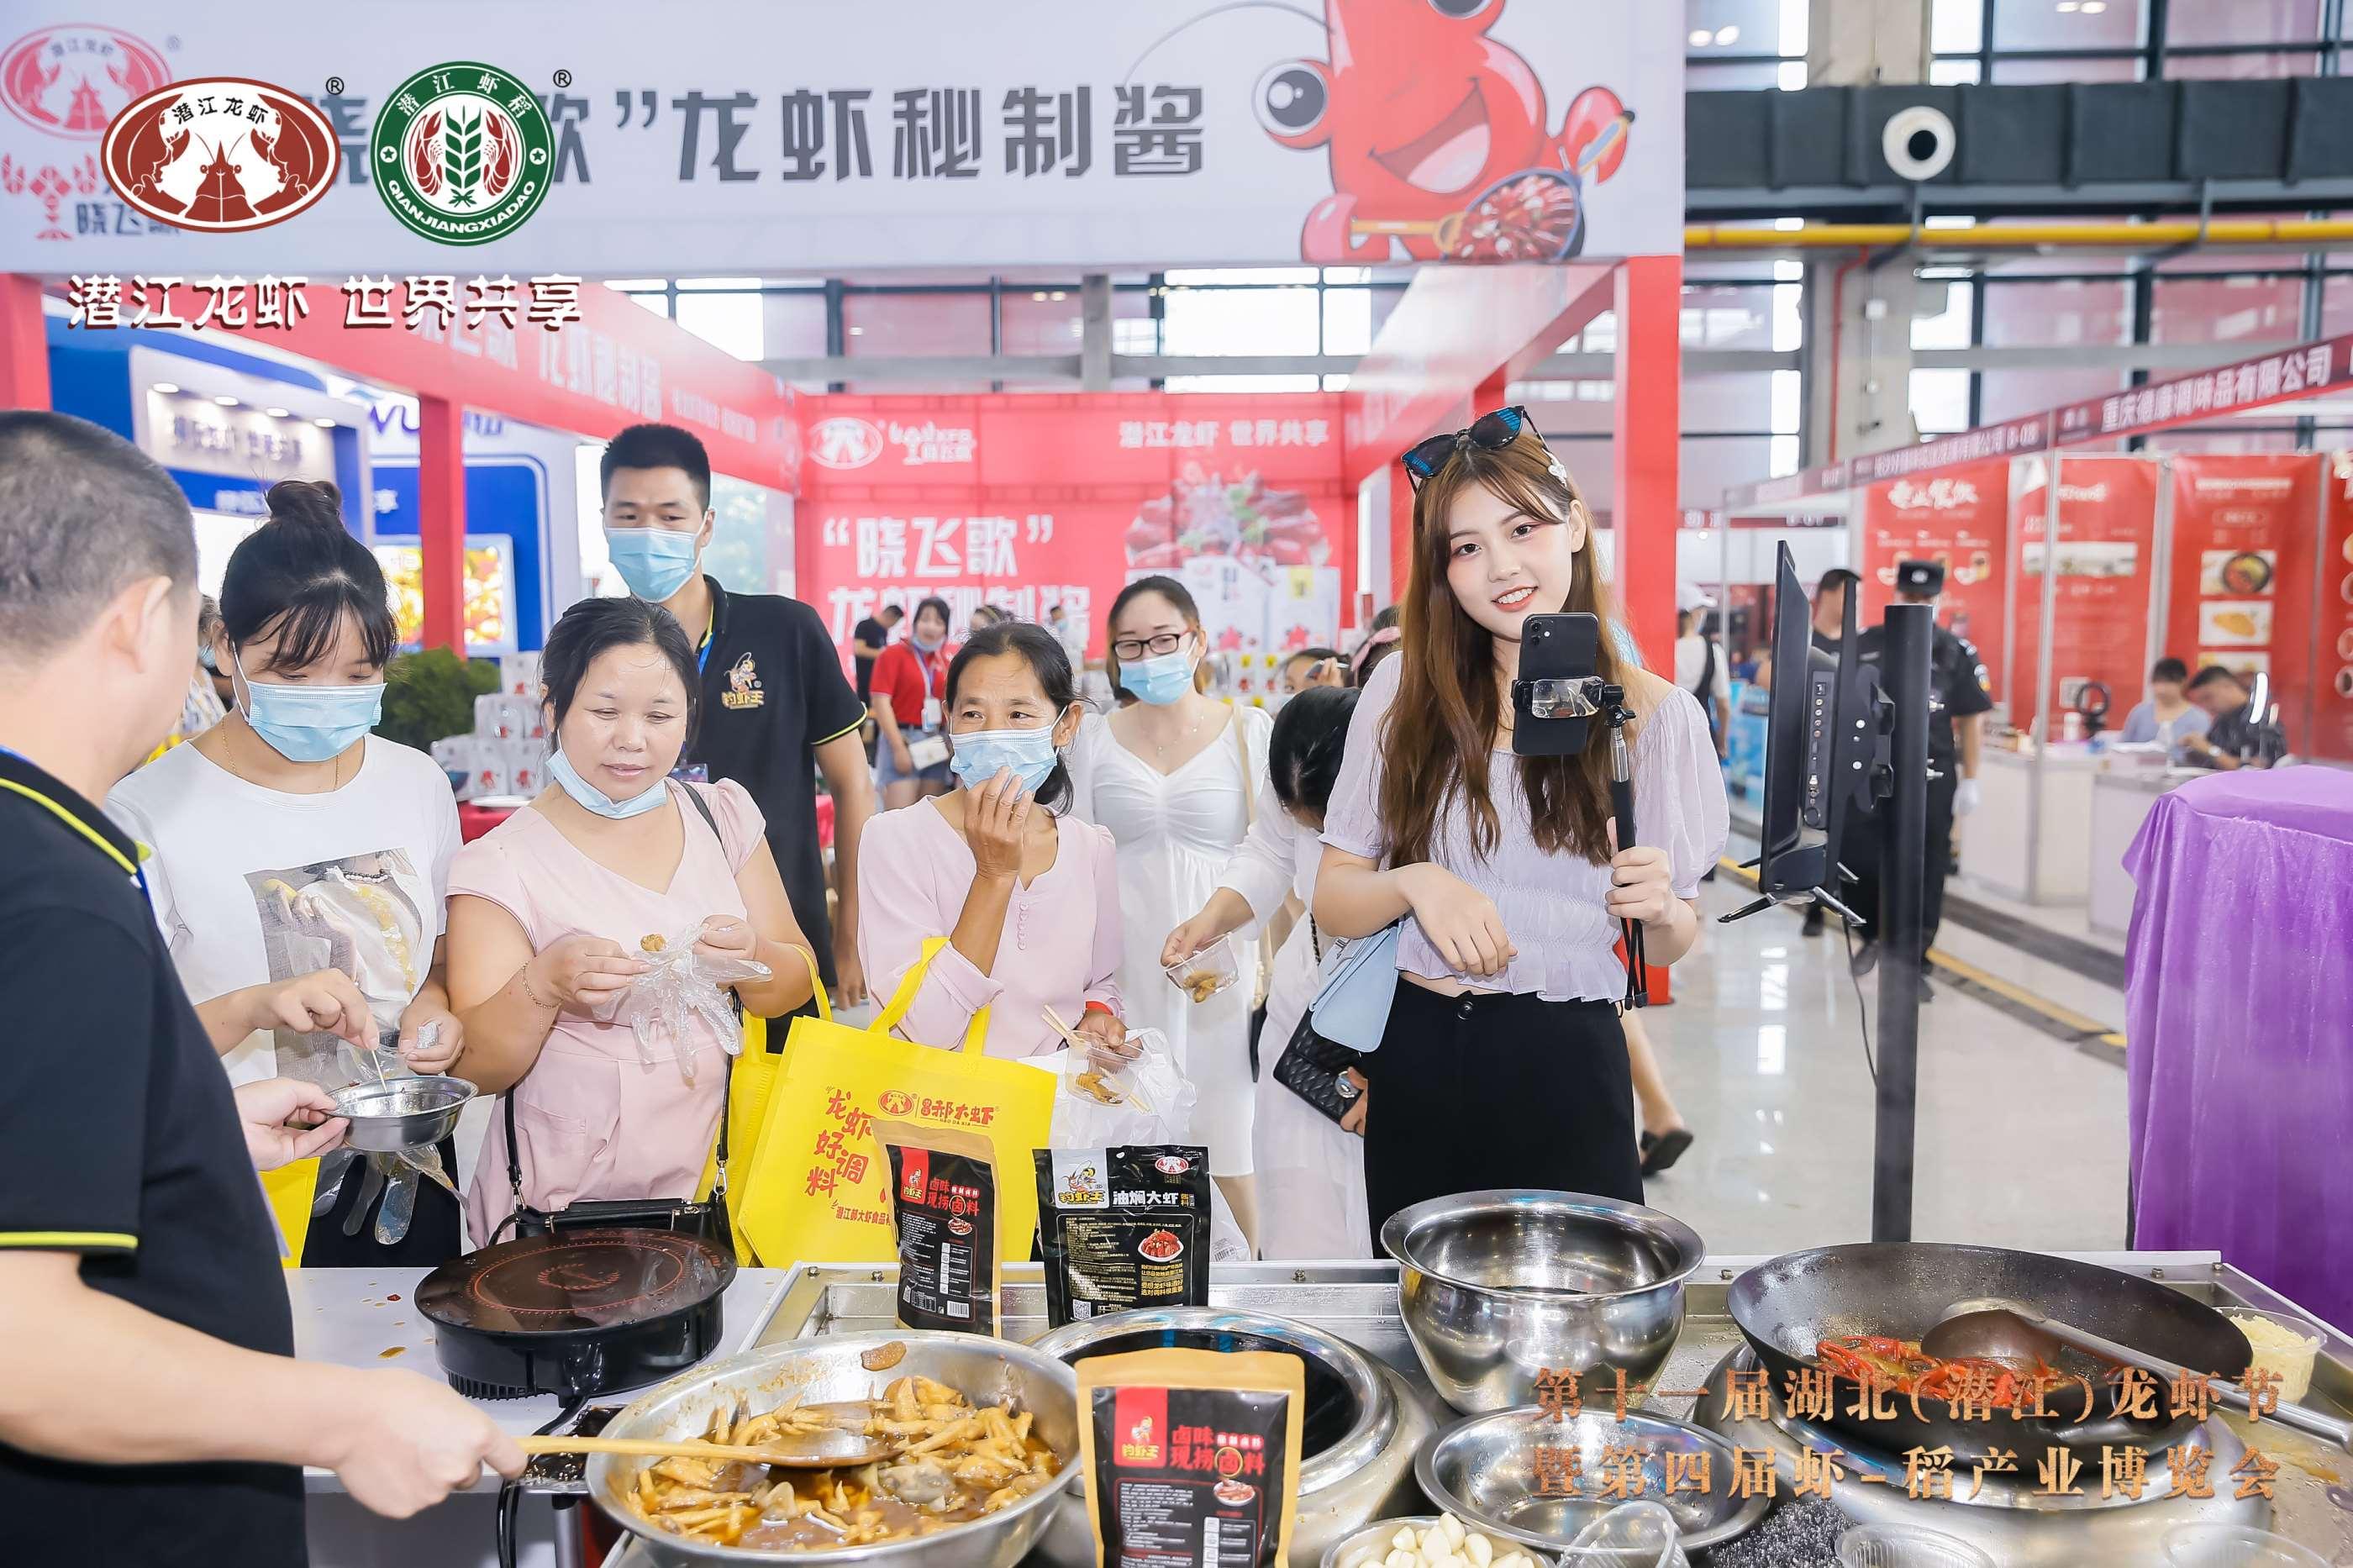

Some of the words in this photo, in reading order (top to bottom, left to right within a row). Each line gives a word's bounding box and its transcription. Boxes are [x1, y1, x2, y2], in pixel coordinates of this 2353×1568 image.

[823, 513, 1054, 578] “晓飞歌”
[1058, 1190, 1105, 1203] 钓虾王
[1113, 1190, 1179, 1206] 油焖大虾
